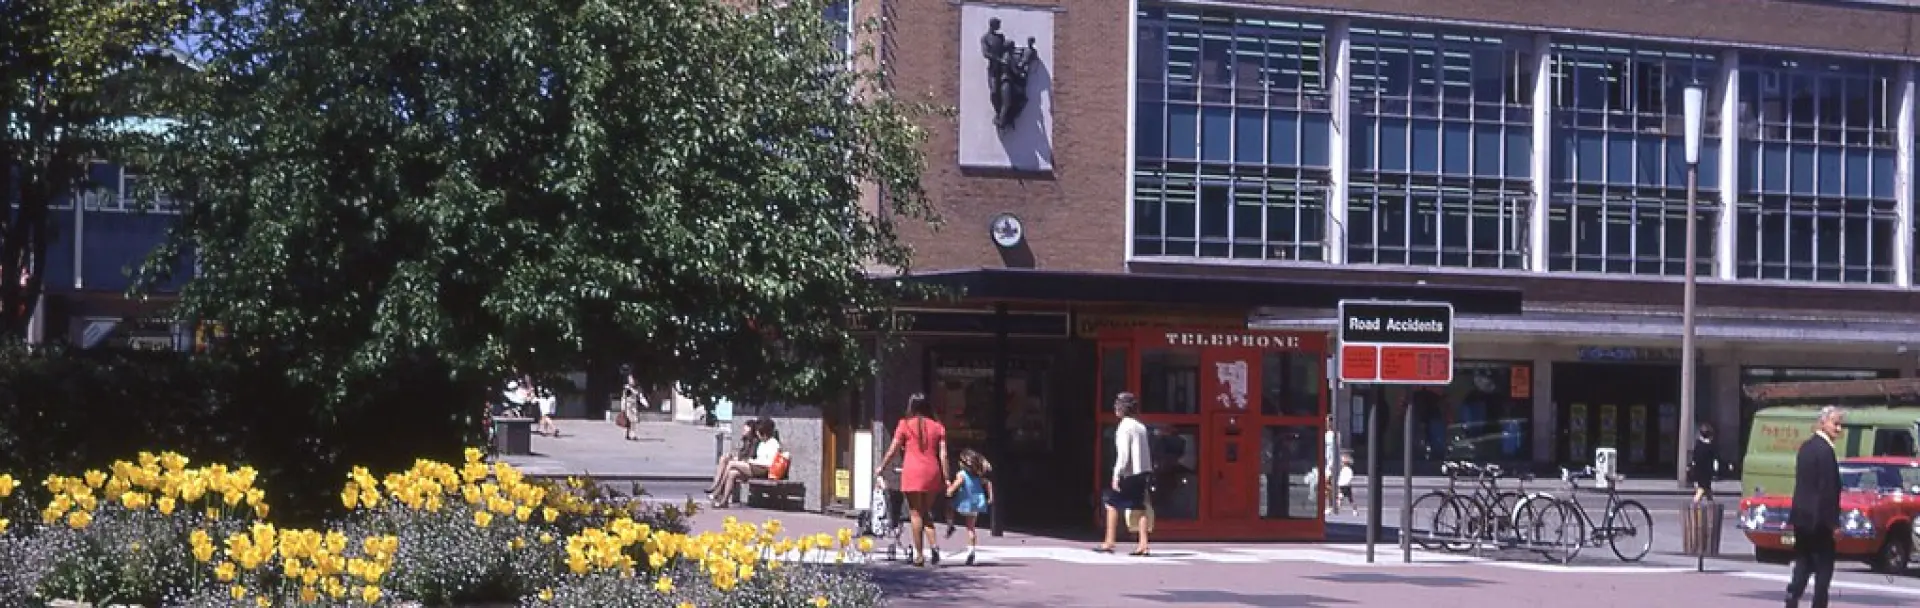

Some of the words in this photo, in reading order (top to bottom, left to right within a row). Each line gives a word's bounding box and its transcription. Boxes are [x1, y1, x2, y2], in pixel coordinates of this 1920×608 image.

[1349, 316, 1381, 331] Road
[1386, 317, 1444, 332] Accidents
[1165, 332, 1300, 349] TELEPHONE
